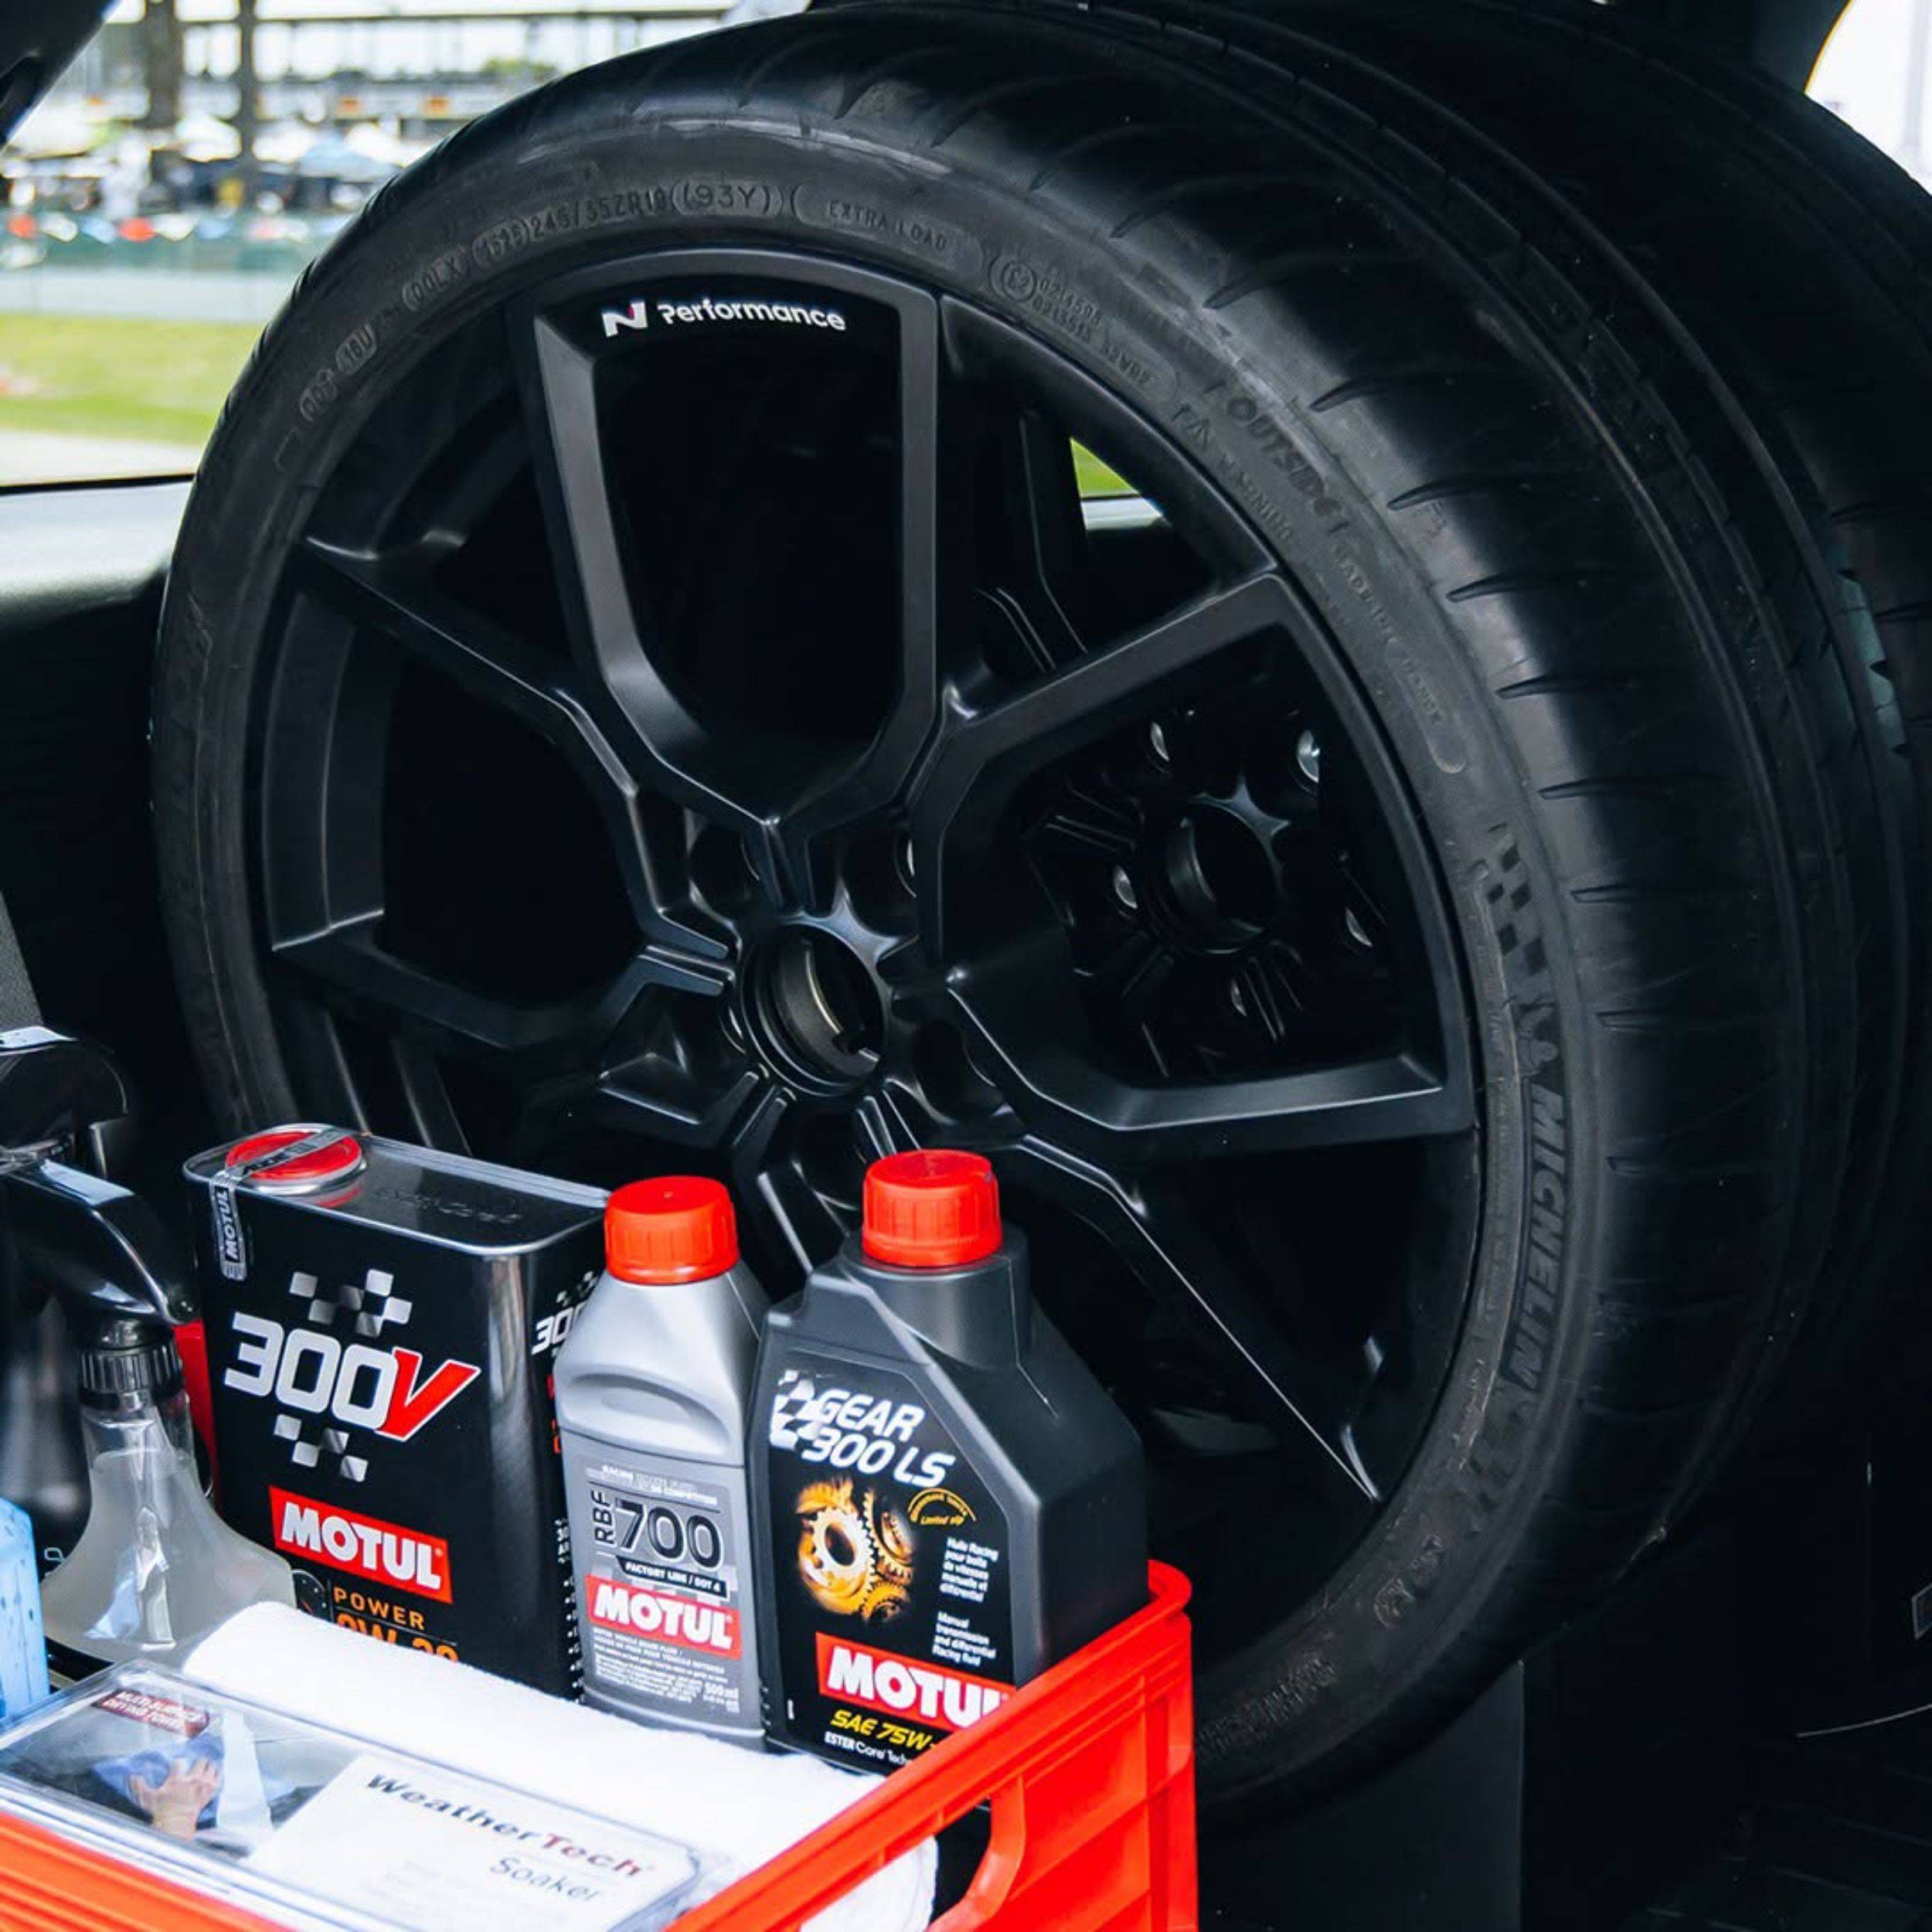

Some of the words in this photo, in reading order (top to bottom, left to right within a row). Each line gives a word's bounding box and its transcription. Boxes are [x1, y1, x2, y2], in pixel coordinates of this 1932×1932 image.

[828, 199, 887, 230] EXTRA
[896, 219, 948, 251] LOAD
[658, 297, 846, 331] Performance
[216, 1189, 240, 1260] MOTUL
[1508, 1082, 1566, 1390] MICHELIN
[531, 1301, 587, 1355] 30
[224, 1311, 481, 1443] 300V
[813, 1388, 926, 1444] GEAR
[801, 1427, 895, 1475] 300
[893, 1447, 957, 1488] LS
[590, 1489, 615, 1545] RBF
[615, 1497, 725, 1571] 700
[281, 1501, 441, 1590] MOTUL
[333, 1586, 426, 1631] POWER
[594, 1584, 733, 1650] MOTUL
[824, 1730, 856, 1752] ESTER
[830, 1709, 879, 1736] SAE
[366, 1774, 643, 1878] WeatherTech
[490, 1856, 603, 1903] Soaker
